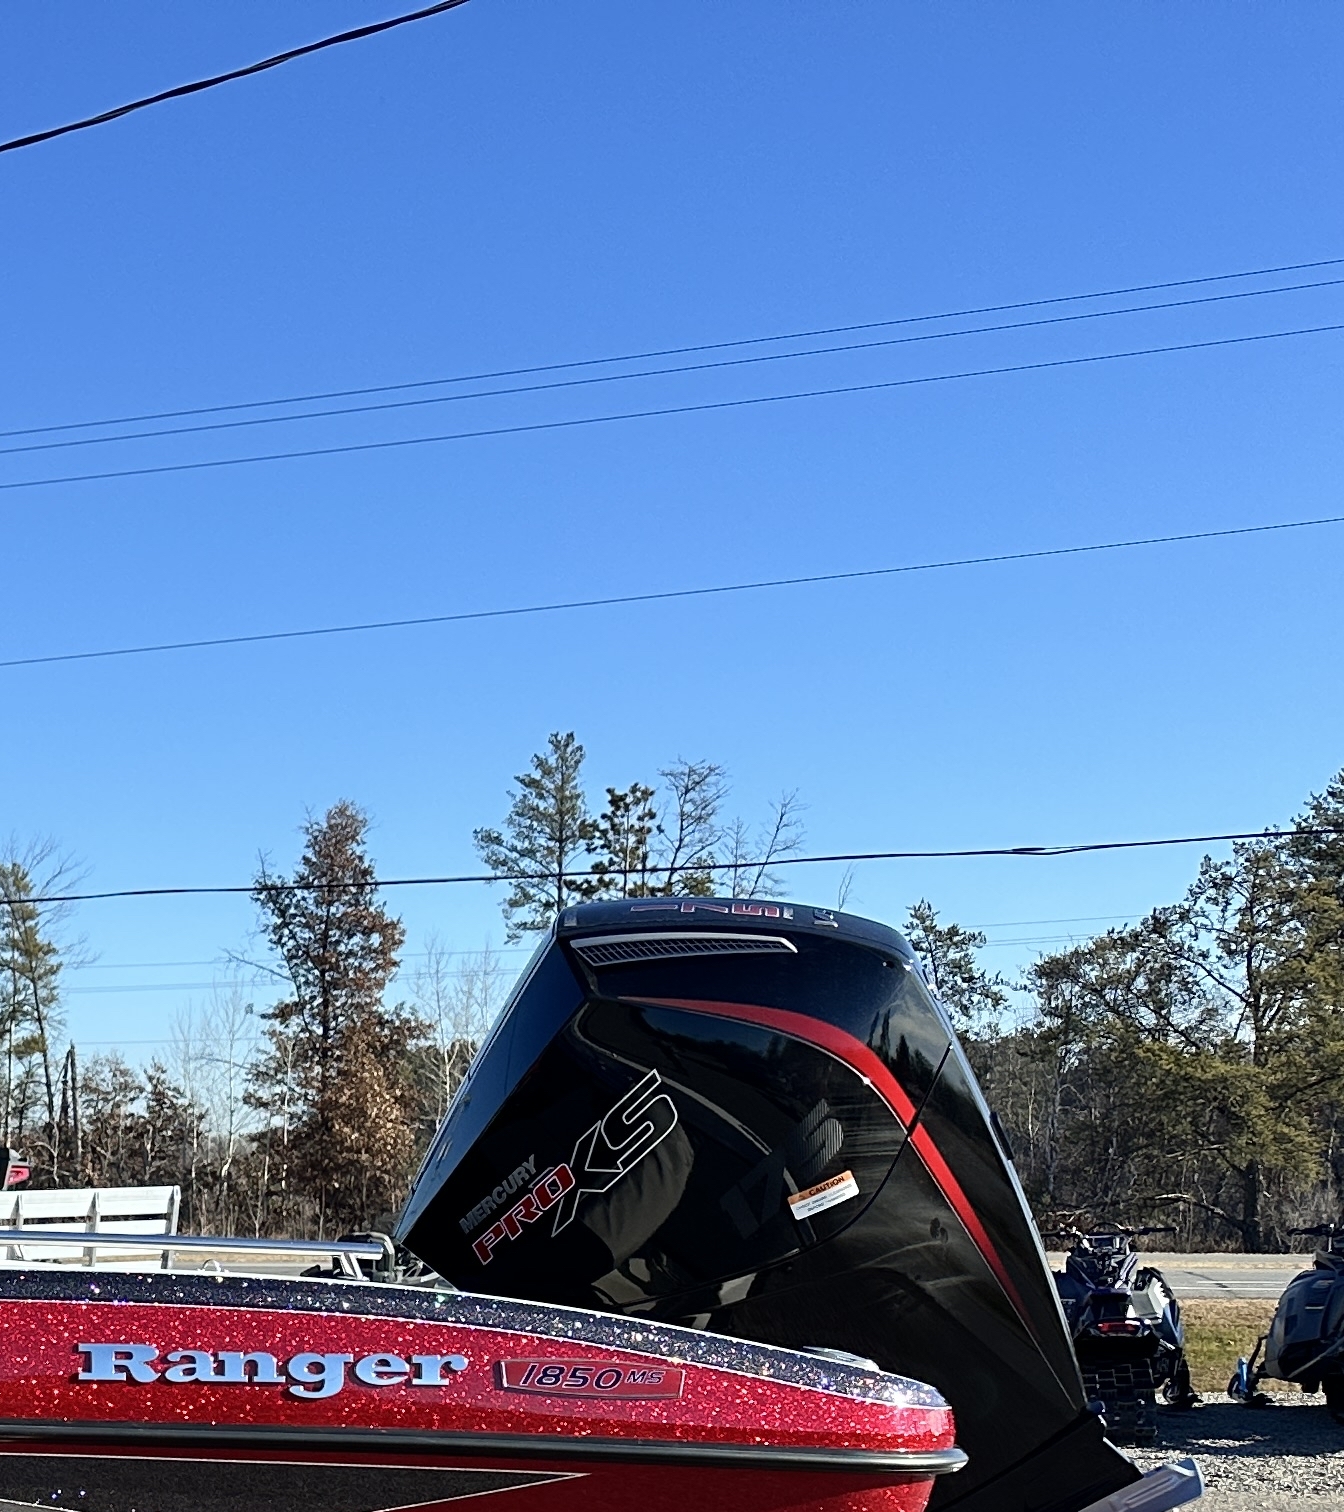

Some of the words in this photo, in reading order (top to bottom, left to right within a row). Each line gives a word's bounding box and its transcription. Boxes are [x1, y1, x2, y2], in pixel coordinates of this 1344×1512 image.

[459, 1154, 538, 1235] MERCURY
[808, 1175, 846, 1196] CAUTION
[472, 1163, 576, 1266] PRO
[76, 1343, 470, 1399] Ranger
[519, 1363, 623, 1391] 1850
[624, 1369, 666, 1384] MS
